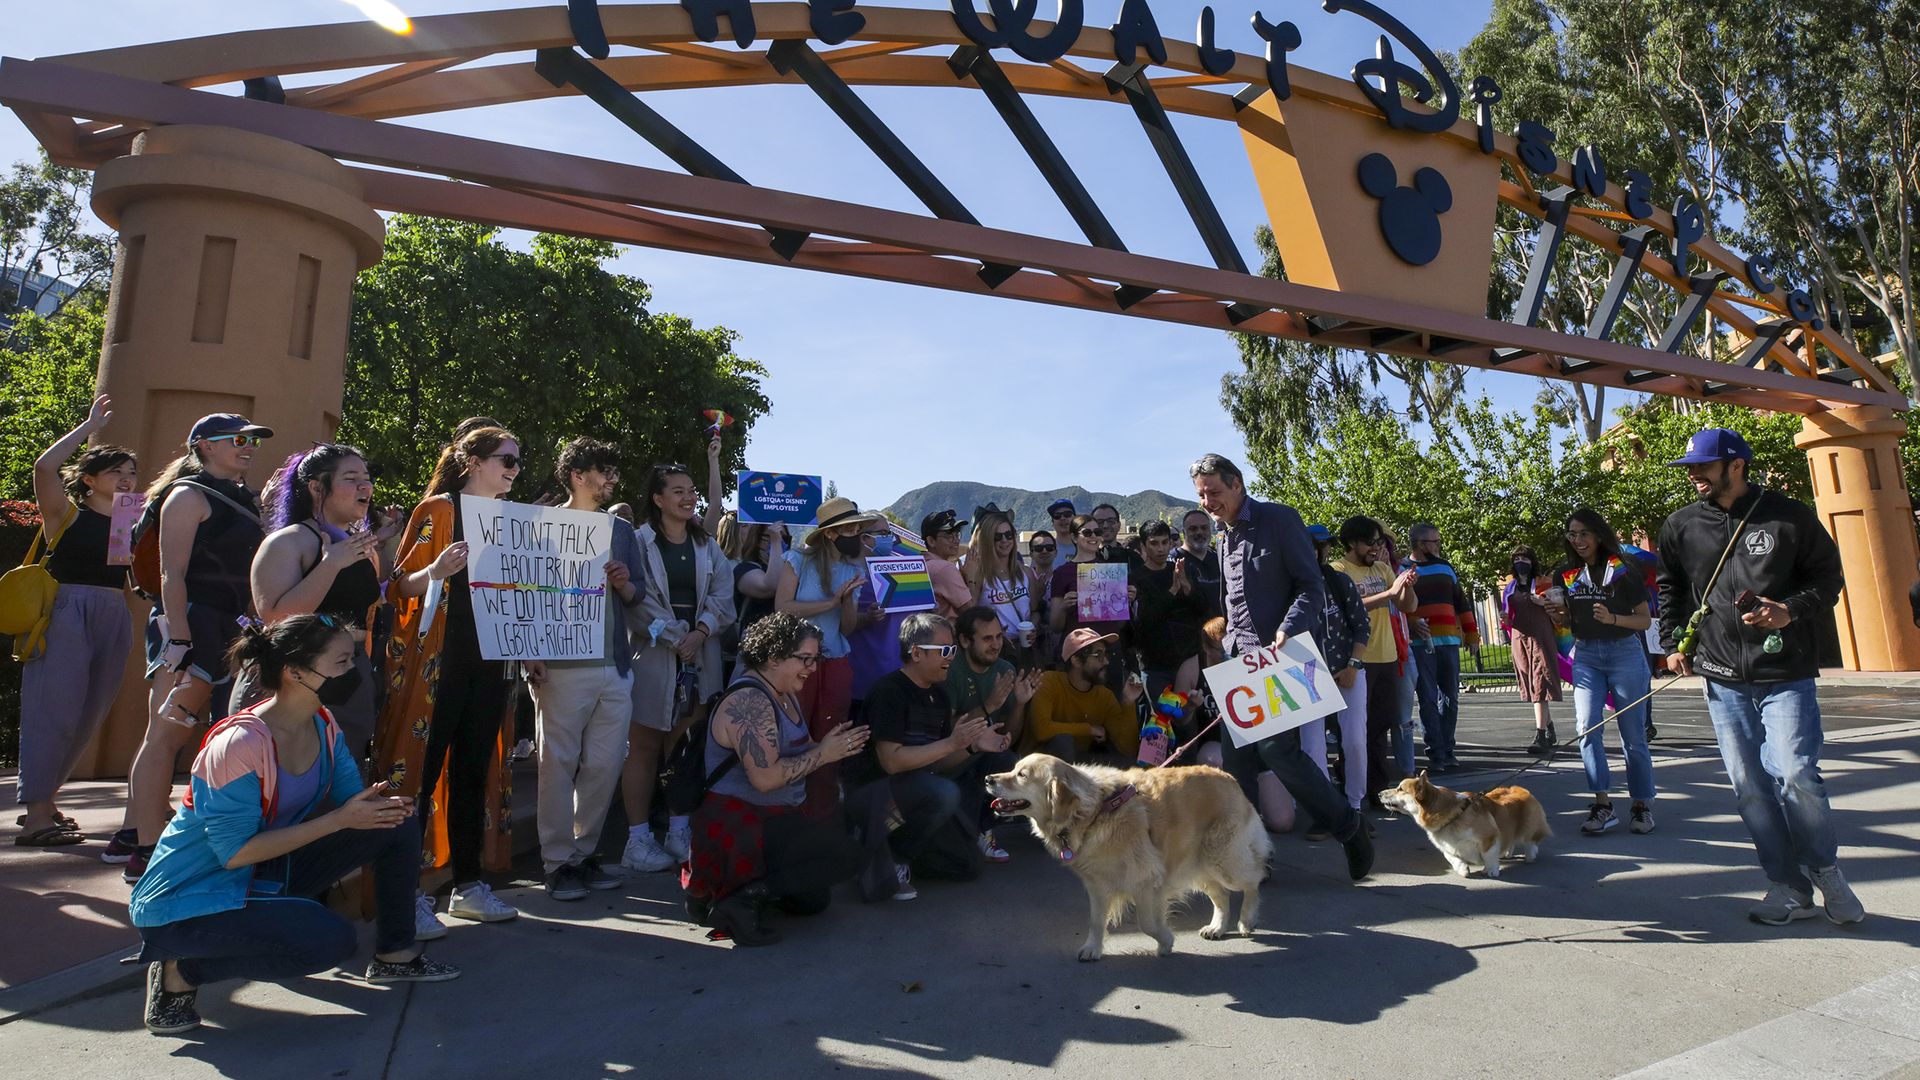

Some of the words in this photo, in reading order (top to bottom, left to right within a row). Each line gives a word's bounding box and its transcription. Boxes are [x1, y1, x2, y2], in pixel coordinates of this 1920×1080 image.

[754, 496, 784, 504] LGBTQIA+
[763, 504, 799, 512] EMPLOYEES
[478, 513, 504, 547] WE
[559, 523, 597, 556] TALK
[501, 552, 544, 588] ABOUT
[873, 562, 923, 572] #DISNEYSAYGAY
[1091, 568, 1120, 580] DISNEY
[1090, 582, 1107, 592] SAY
[481, 588, 510, 616] WE
[515, 589, 536, 621] DO
[538, 589, 569, 622] TALK
[569, 594, 605, 623] ABOUT
[1090, 593, 1107, 606] GAY
[495, 622, 545, 658] LGBTQ+
[545, 624, 593, 657] RIGHTS!
[1242, 646, 1279, 674] SAY
[1225, 658, 1323, 729] GAY
